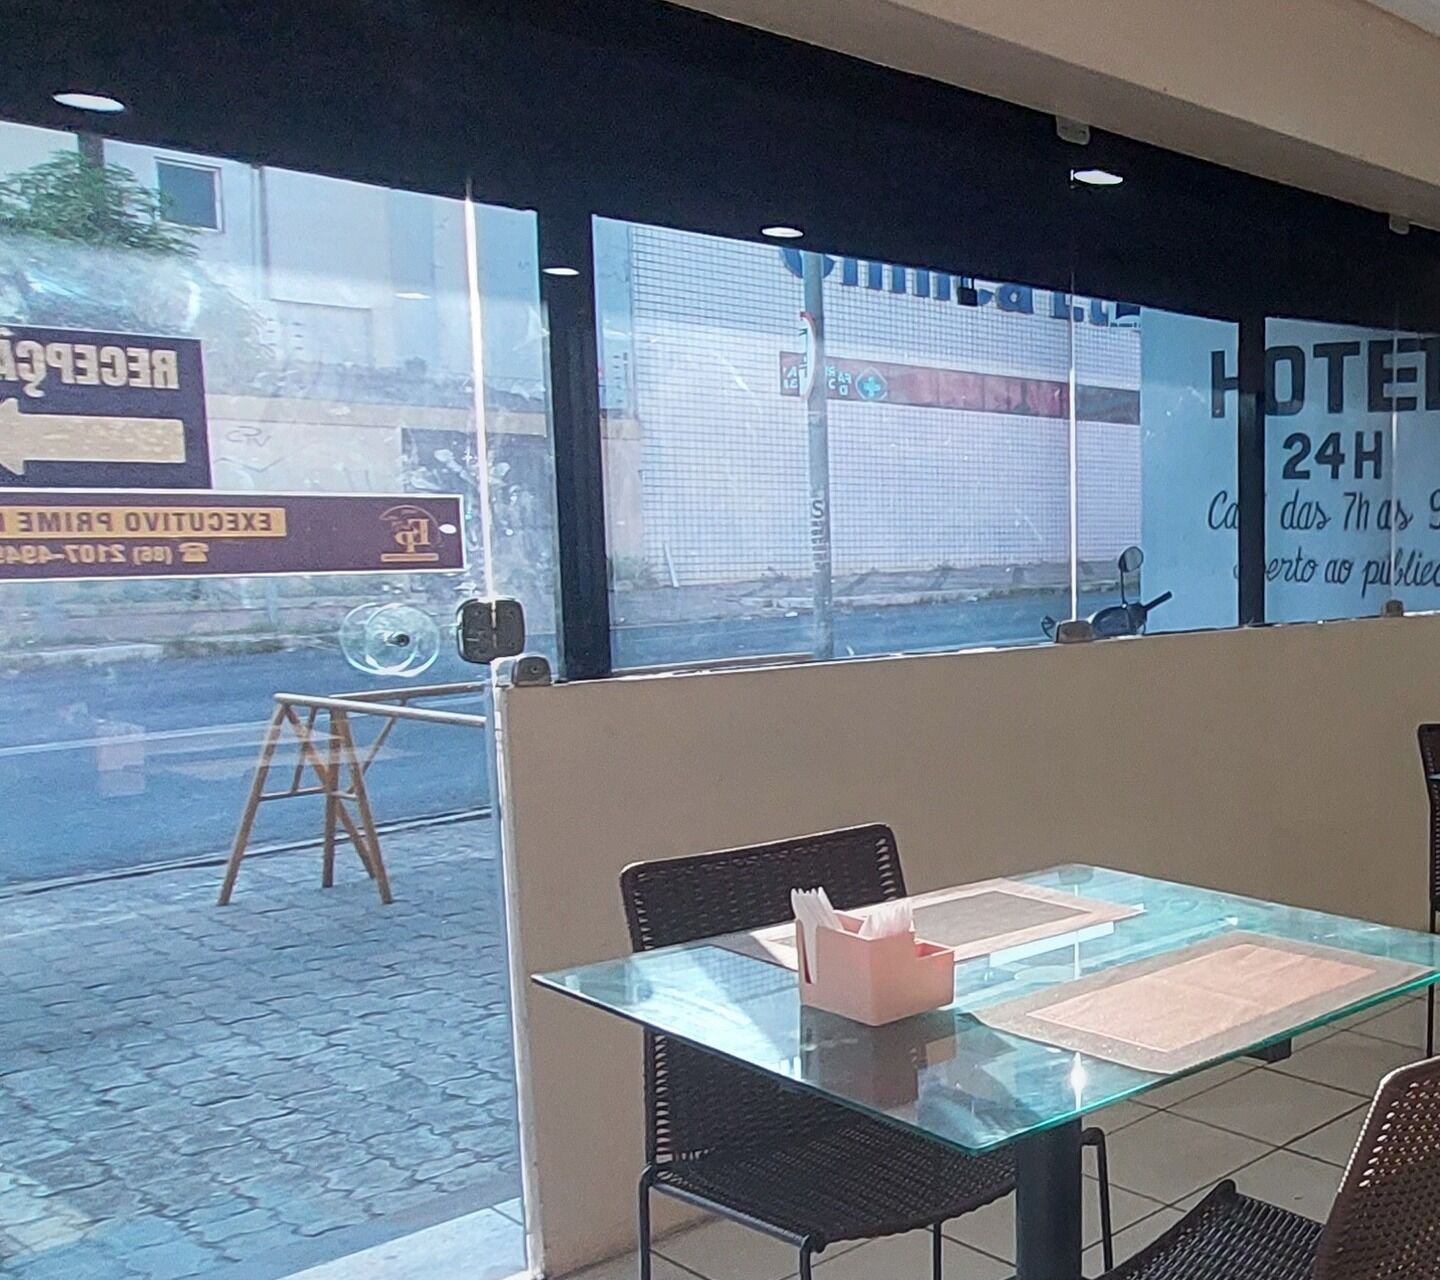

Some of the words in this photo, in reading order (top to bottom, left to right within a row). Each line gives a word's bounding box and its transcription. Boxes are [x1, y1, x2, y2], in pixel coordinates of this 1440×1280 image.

[1282, 431, 1383, 480] 24H
[1280, 488, 1332, 530] das
[1343, 492, 1370, 531] 7h
[1233, 545, 1319, 582] erto
[1324, 559, 1354, 584] ao
